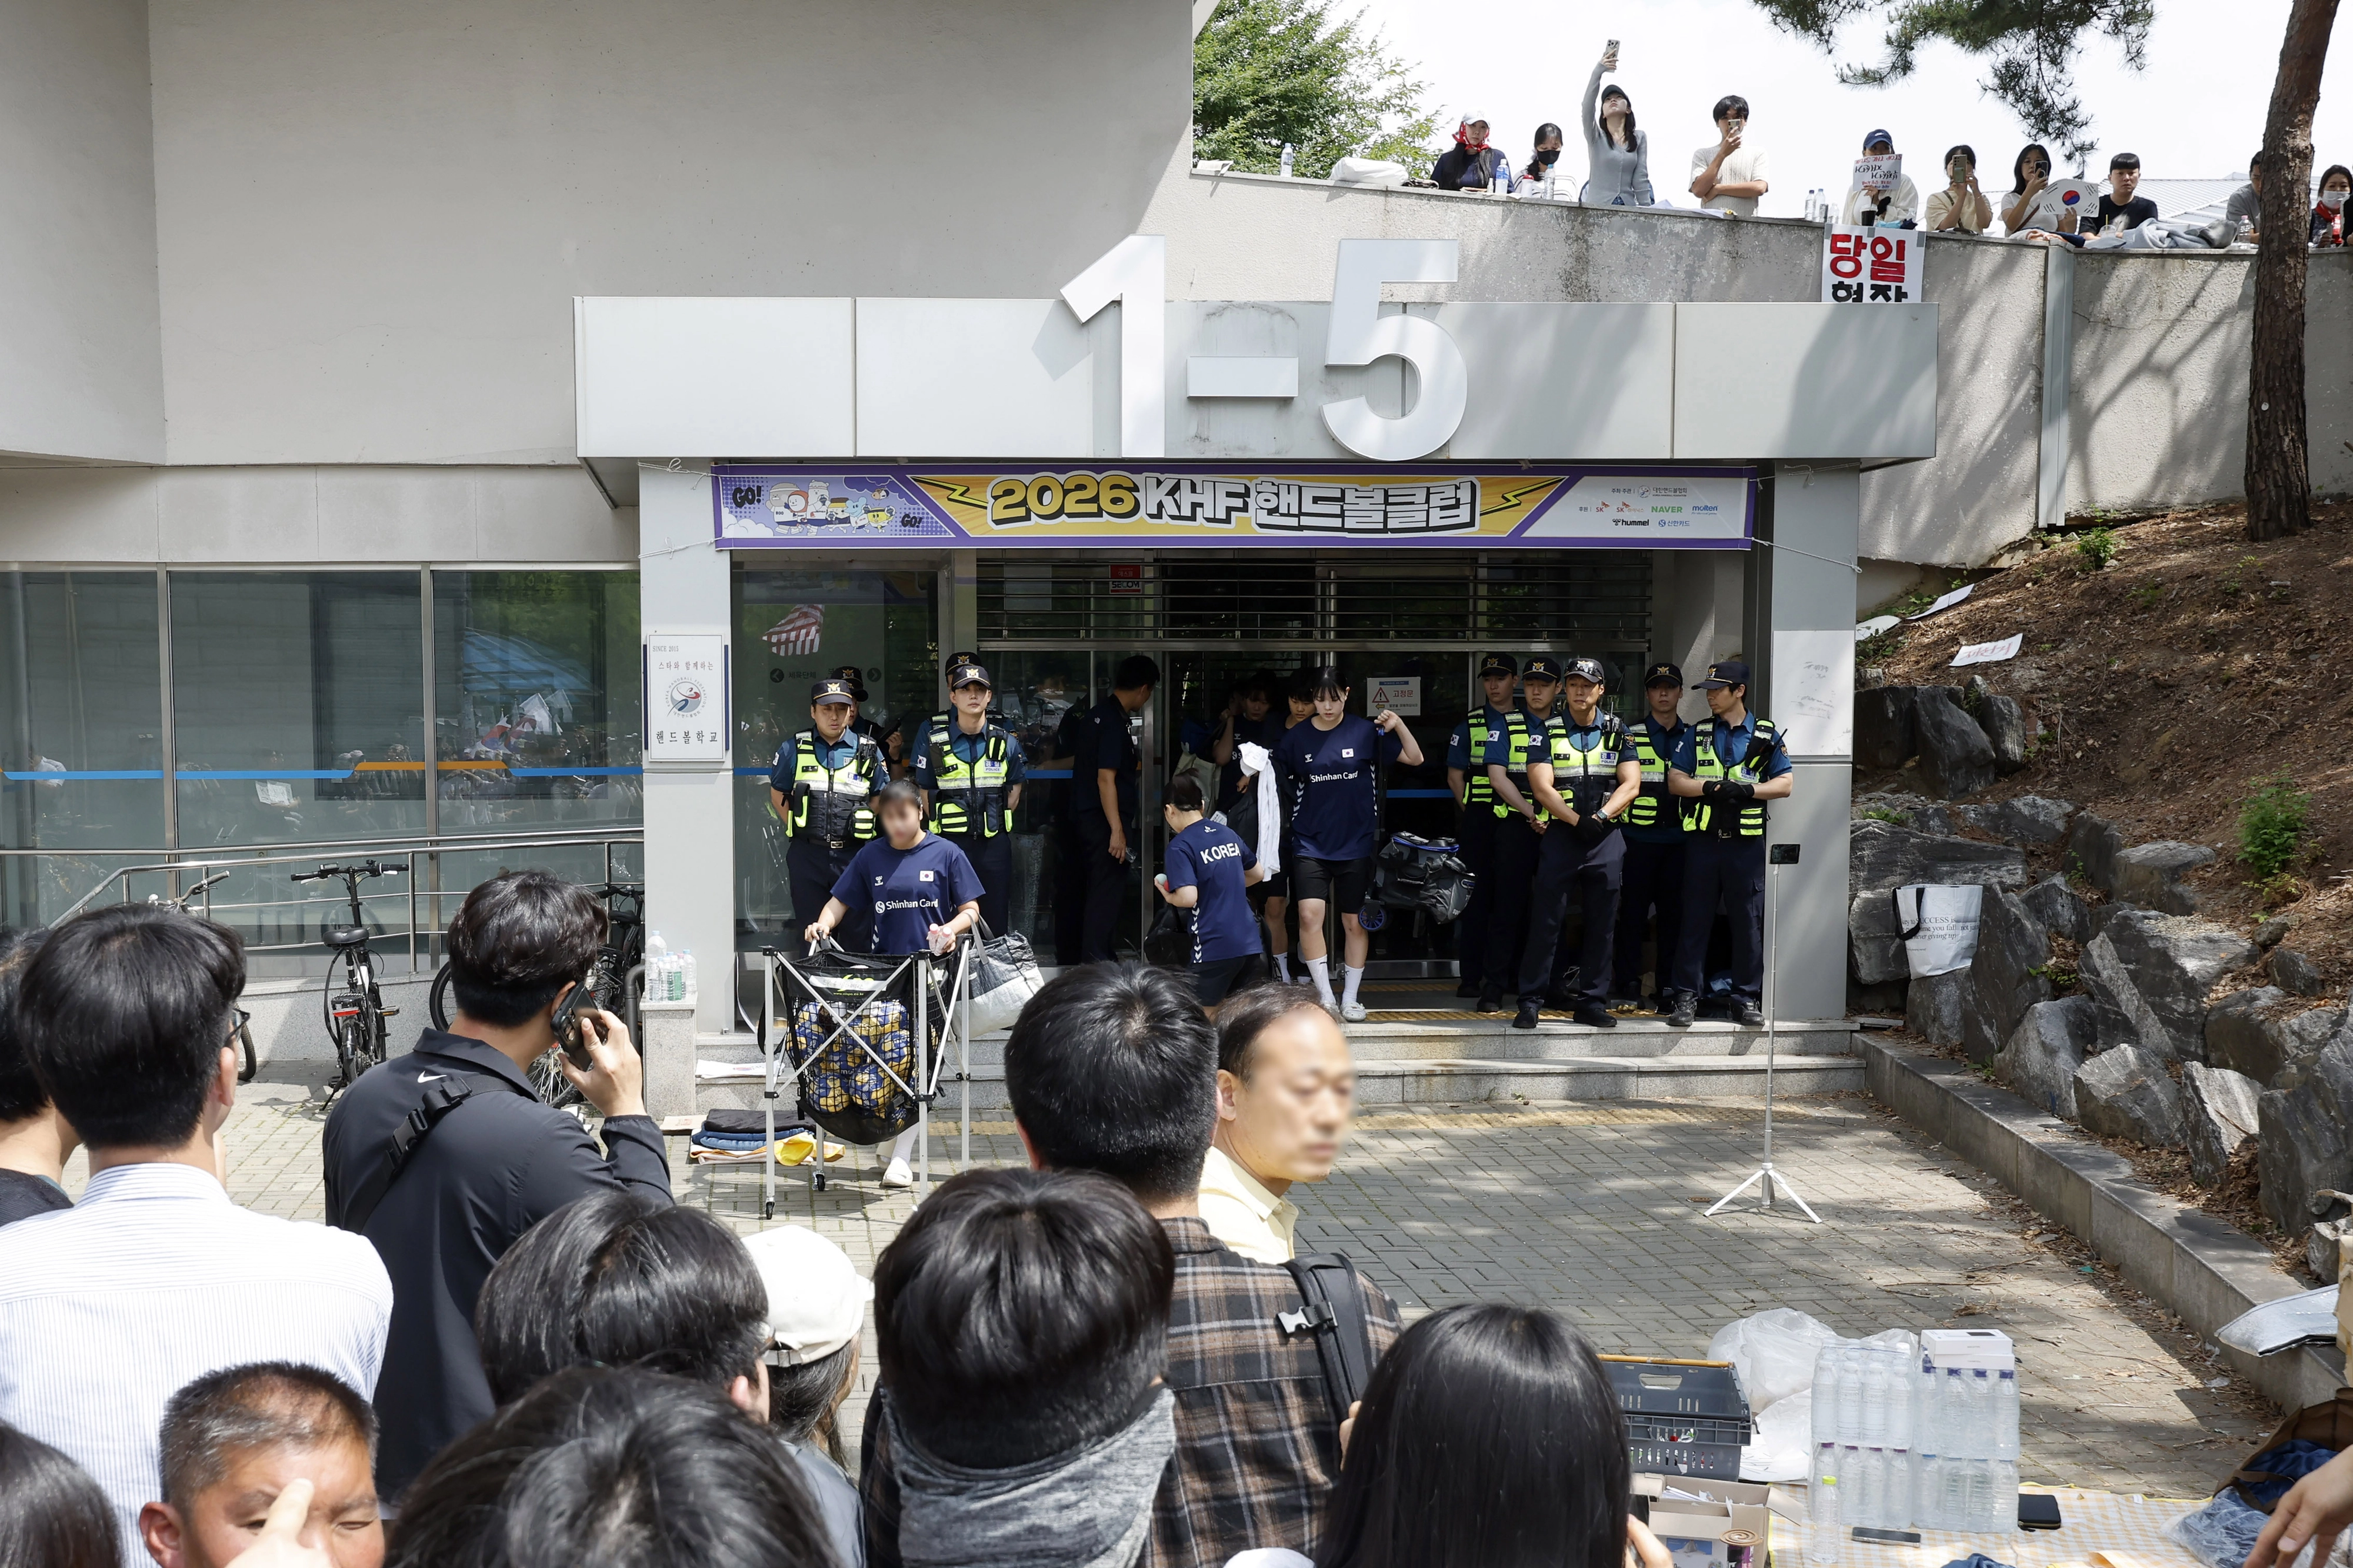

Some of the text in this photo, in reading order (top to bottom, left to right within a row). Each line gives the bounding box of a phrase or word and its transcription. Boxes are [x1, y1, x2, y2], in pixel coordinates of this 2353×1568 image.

[1855, 165, 1882, 173] 재선거
[1829, 233, 1906, 283] 당일
[1059, 234, 1468, 462] 1-5
[732, 485, 762, 508] GO!
[991, 473, 1478, 532] 2026 KHF 핸드볼클럽
[901, 513, 922, 528] GO!
[658, 661, 714, 671] 스타와 함께하는
[669, 676, 692, 689] HANDBALL
[694, 679, 707, 708] FEDERATION
[1601, 752, 1616, 760] 경찰
[1311, 770, 1358, 783] Shinhan Card
[1200, 843, 1241, 864] KOREA
[885, 898, 938, 910] Shinhan Card
